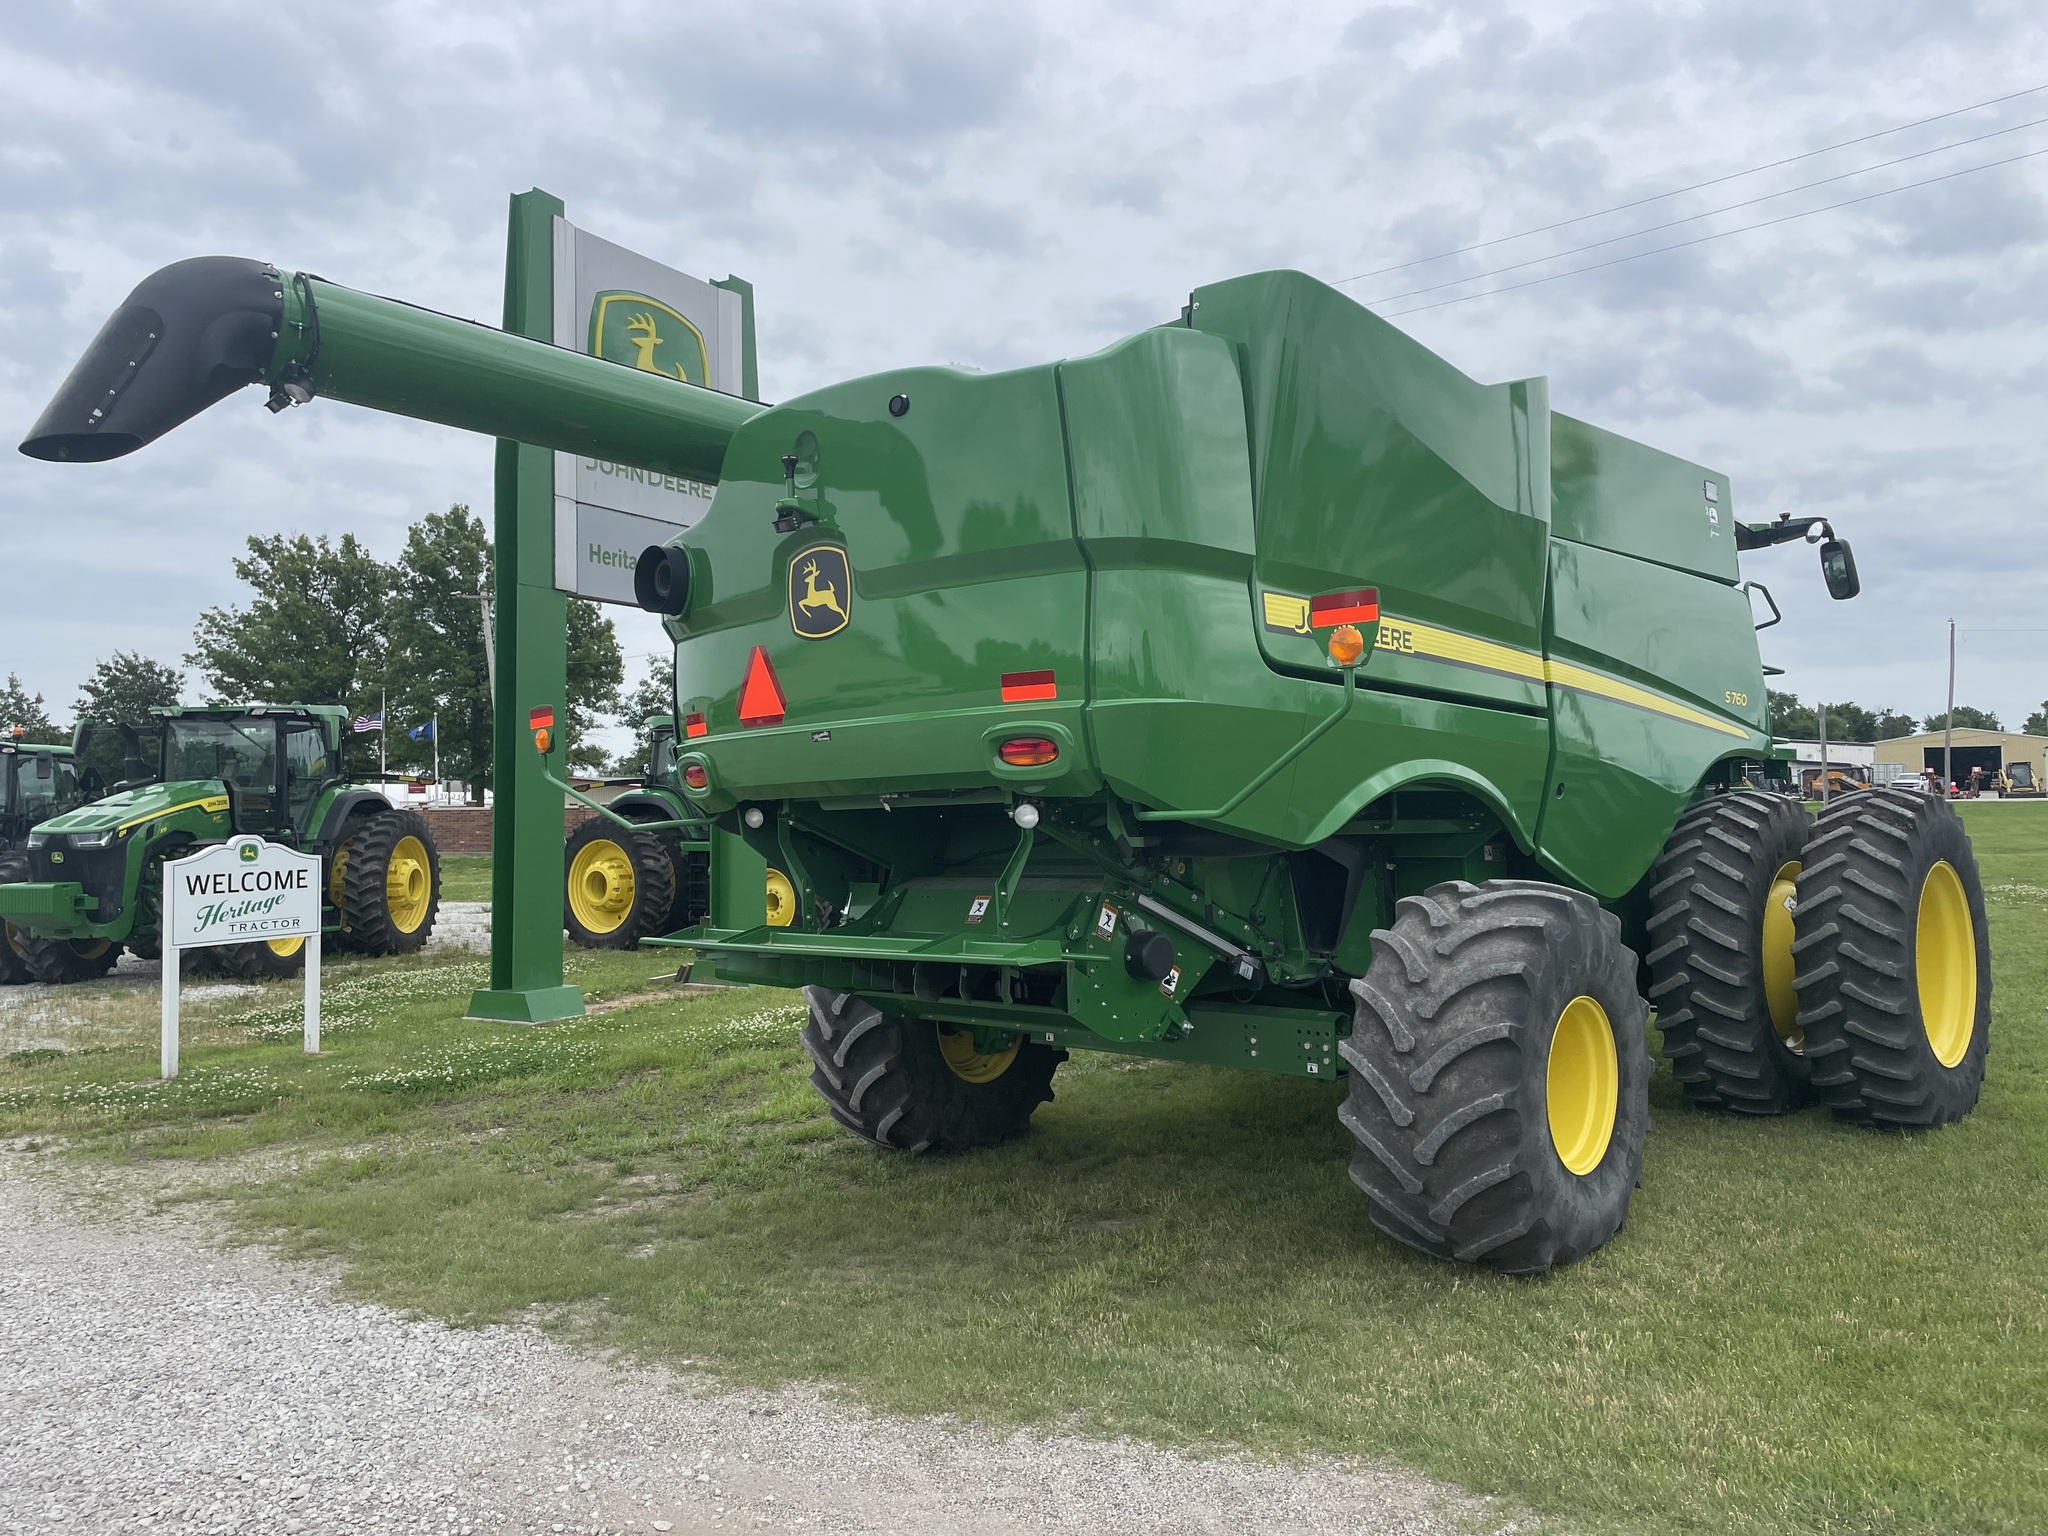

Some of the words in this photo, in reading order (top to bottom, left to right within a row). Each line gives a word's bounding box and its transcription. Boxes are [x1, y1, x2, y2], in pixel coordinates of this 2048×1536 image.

[1725, 690, 1748, 707] S760
[186, 869, 308, 896] WELCOME
[193, 893, 286, 933] Heritage
[228, 918, 300, 933] TRACTOR
